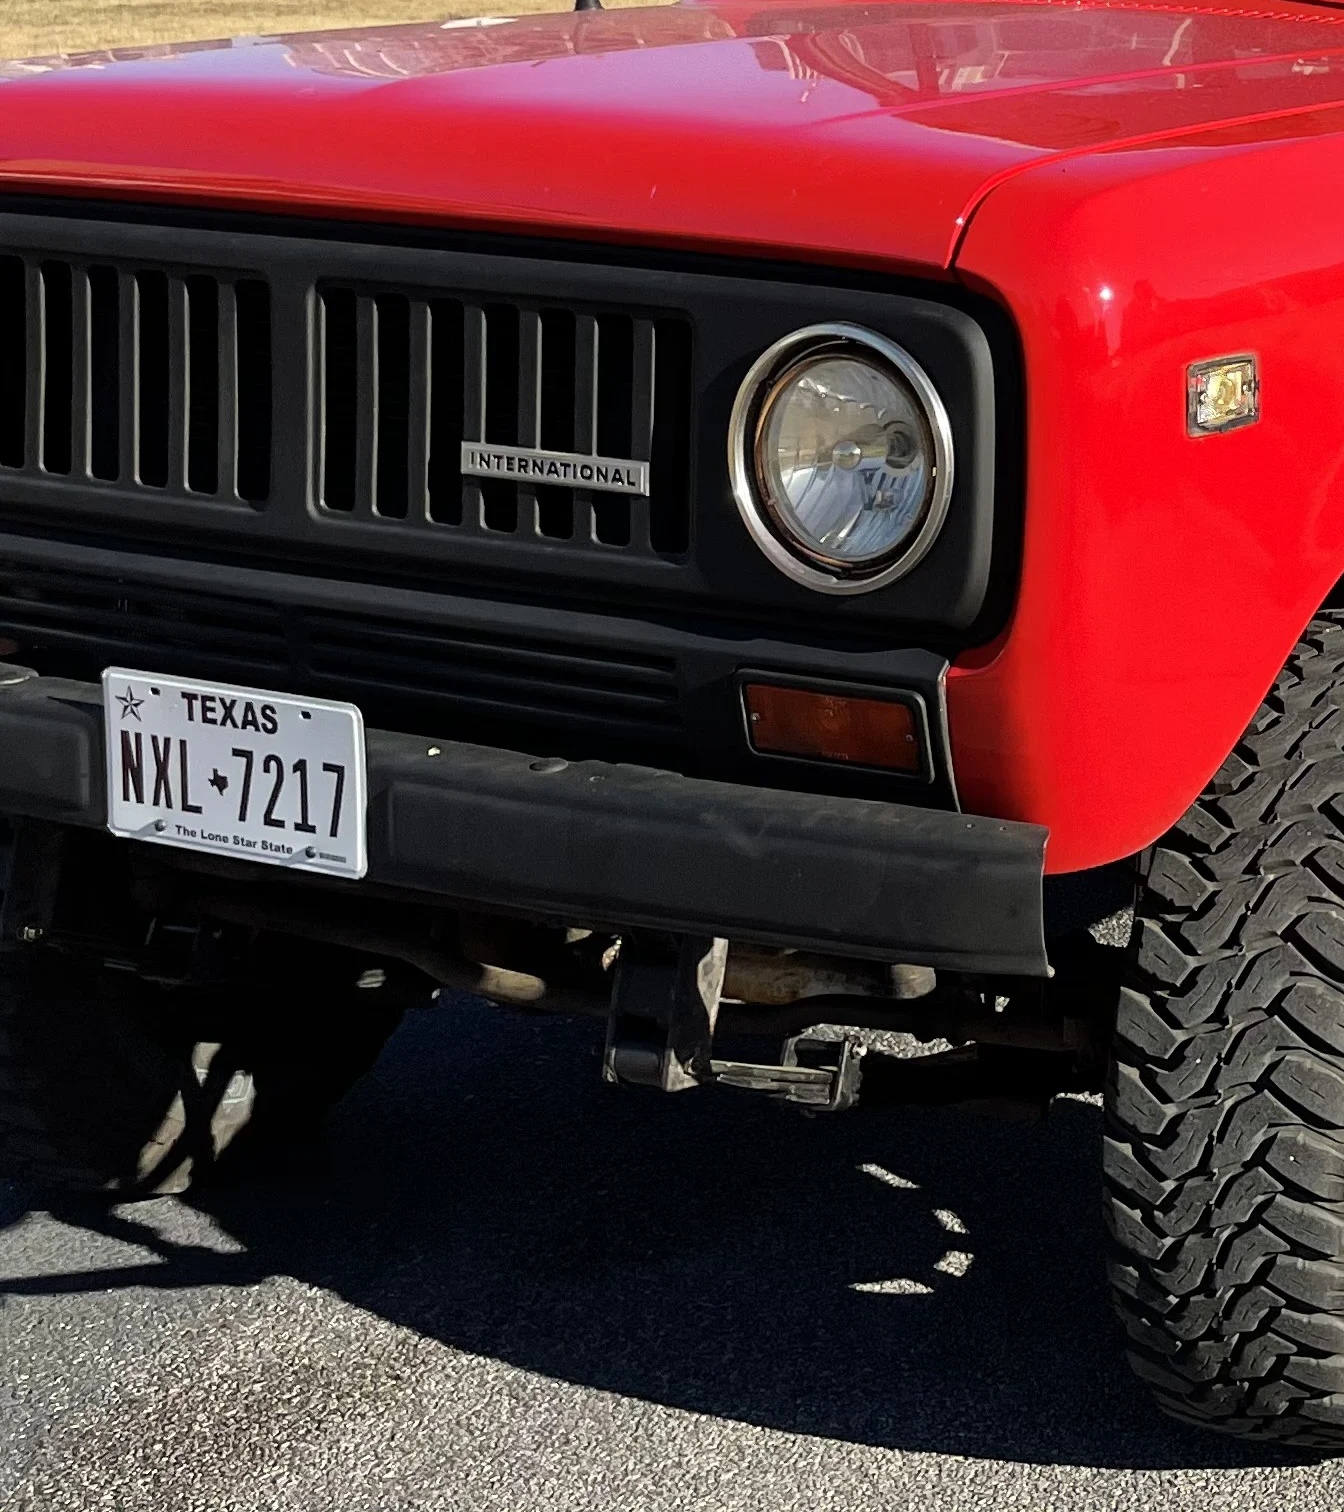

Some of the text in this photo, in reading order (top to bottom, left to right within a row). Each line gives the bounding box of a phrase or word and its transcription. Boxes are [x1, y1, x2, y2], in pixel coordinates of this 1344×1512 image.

[470, 451, 636, 487] INTERNATIONAL
[180, 691, 278, 735] TEXAS
[120, 729, 345, 838] NXL 7217
[175, 824, 293, 855] The Lone Star State
